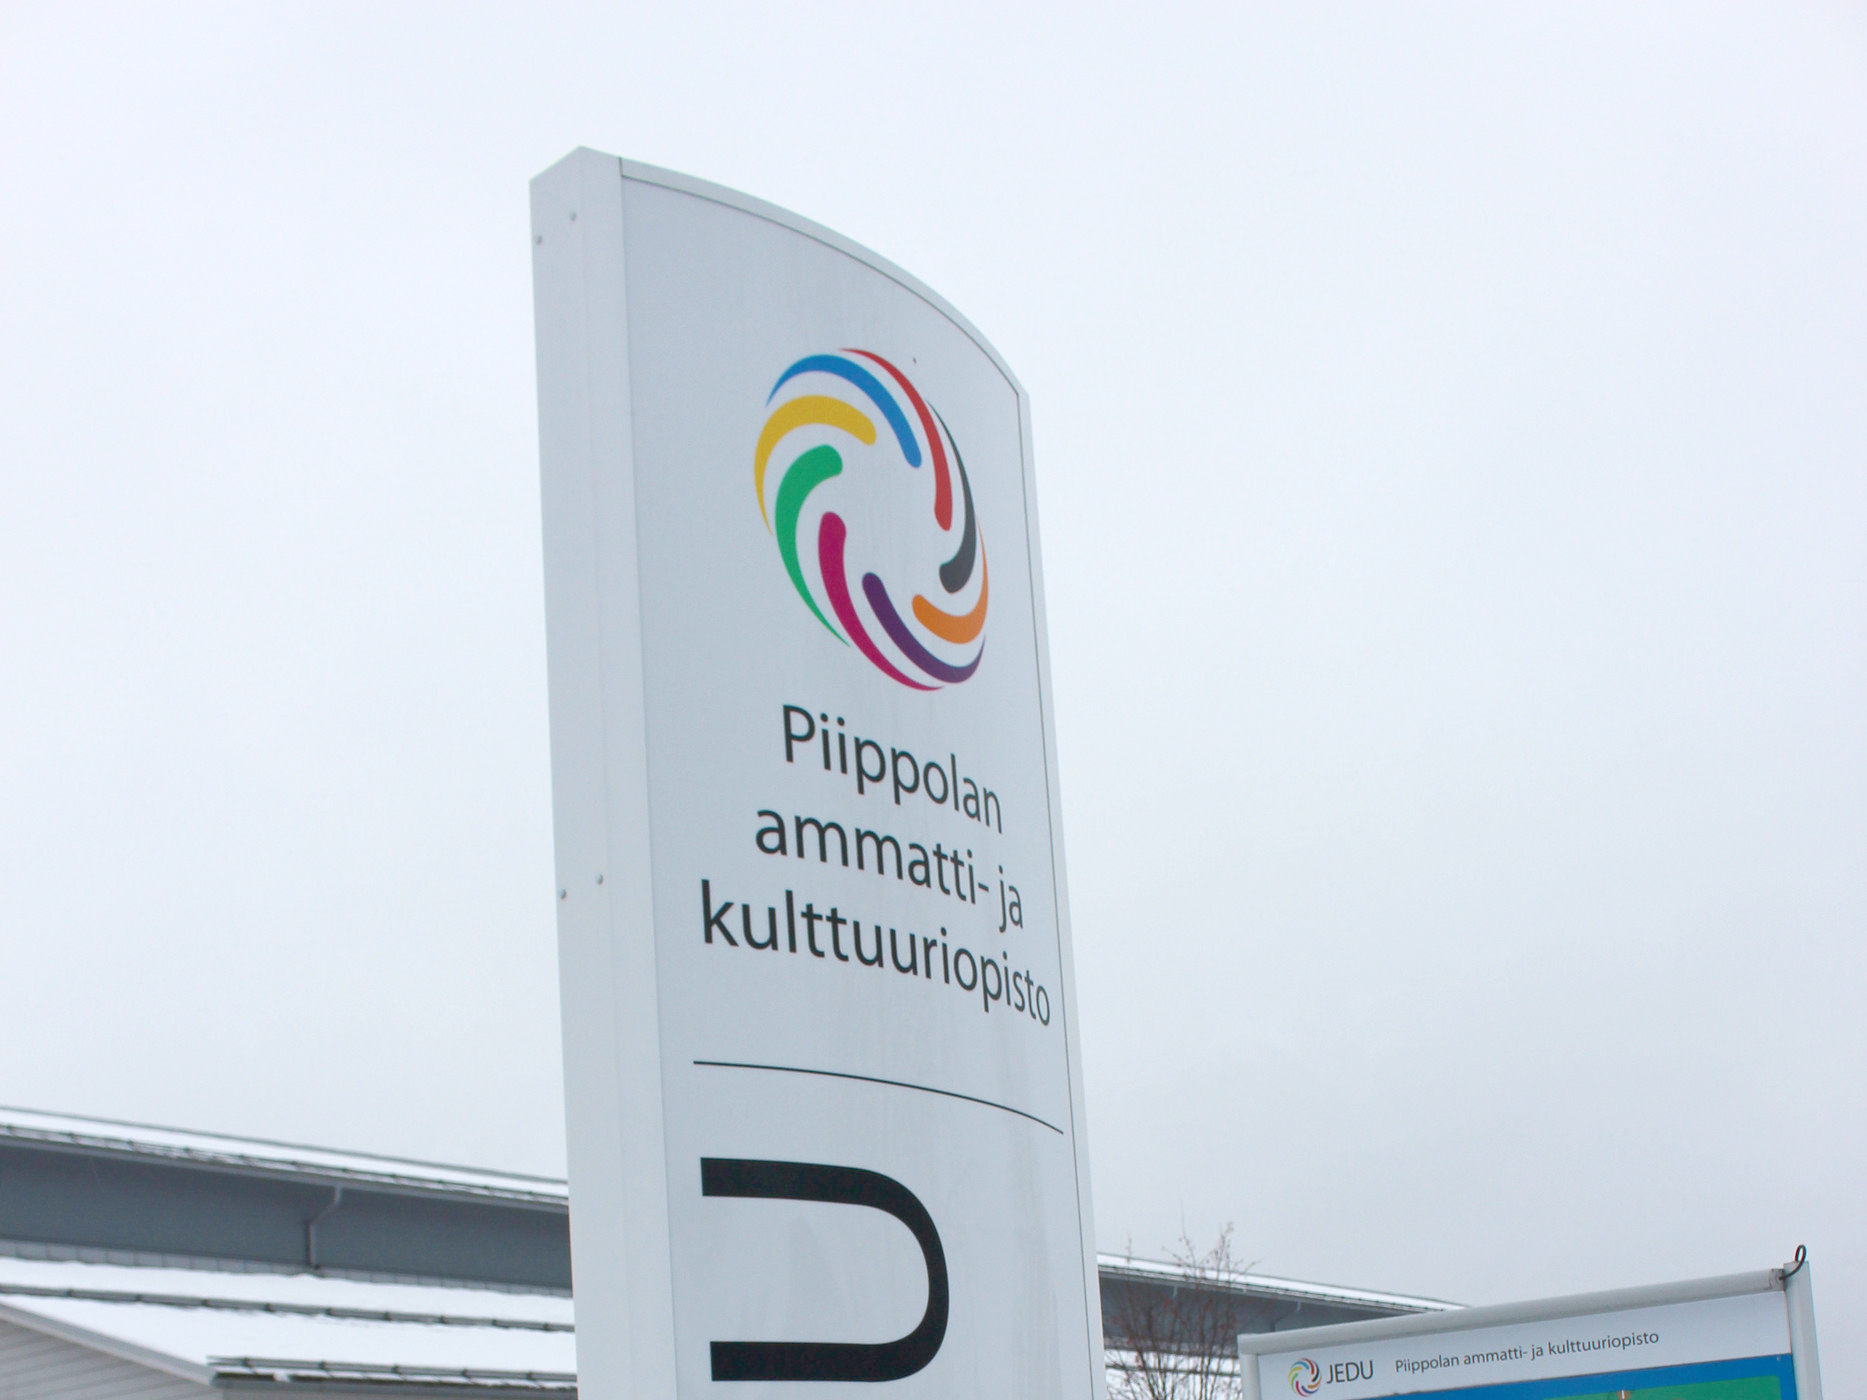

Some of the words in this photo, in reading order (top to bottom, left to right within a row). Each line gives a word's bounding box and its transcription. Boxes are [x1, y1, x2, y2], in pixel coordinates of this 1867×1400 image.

[782, 703, 1003, 835] Piippolan
[755, 808, 989, 905] ammatti-
[998, 864, 1024, 933] ja
[701, 878, 1051, 1027] kulttuuriopisto
[1326, 1360, 1374, 1384] JEDU
[1395, 1354, 1460, 1374] Piippolan
[1463, 1346, 1528, 1365] ammatti-
[1530, 1344, 1544, 1361] ja
[1548, 1332, 1659, 1355] kulttuuriopisto
